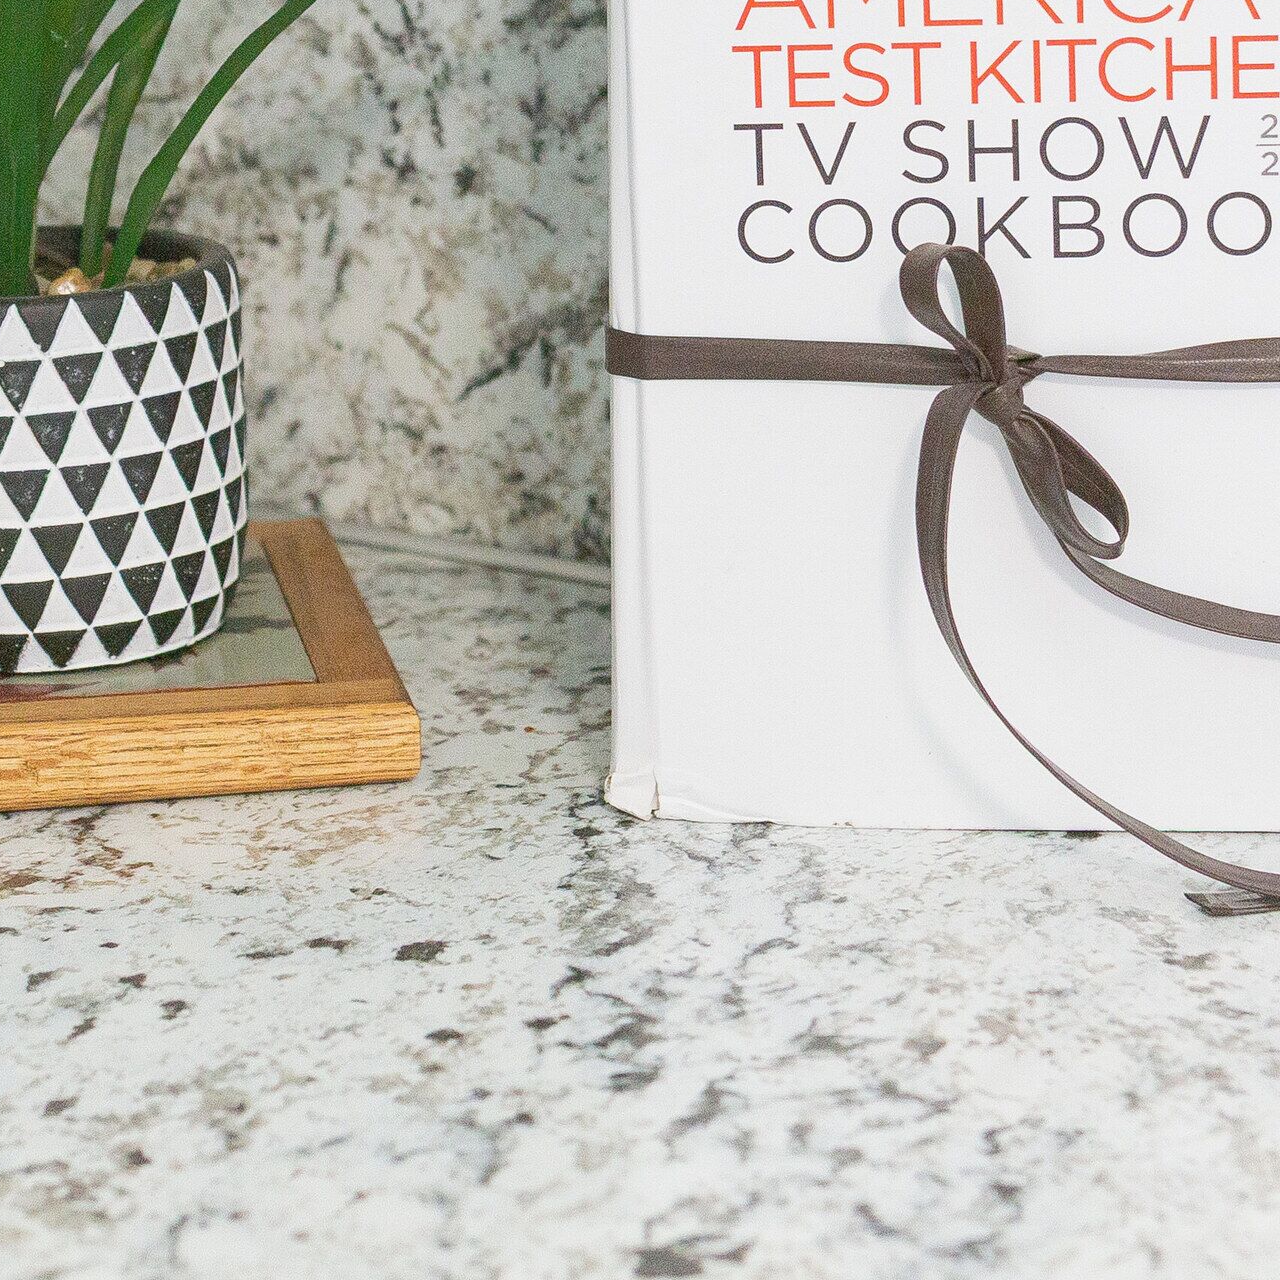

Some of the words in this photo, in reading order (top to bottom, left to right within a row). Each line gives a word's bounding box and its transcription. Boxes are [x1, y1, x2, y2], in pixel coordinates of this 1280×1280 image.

[730, 41, 942, 109] TEST
[732, 121, 858, 187] TV
[901, 114, 1211, 185] SHOW
